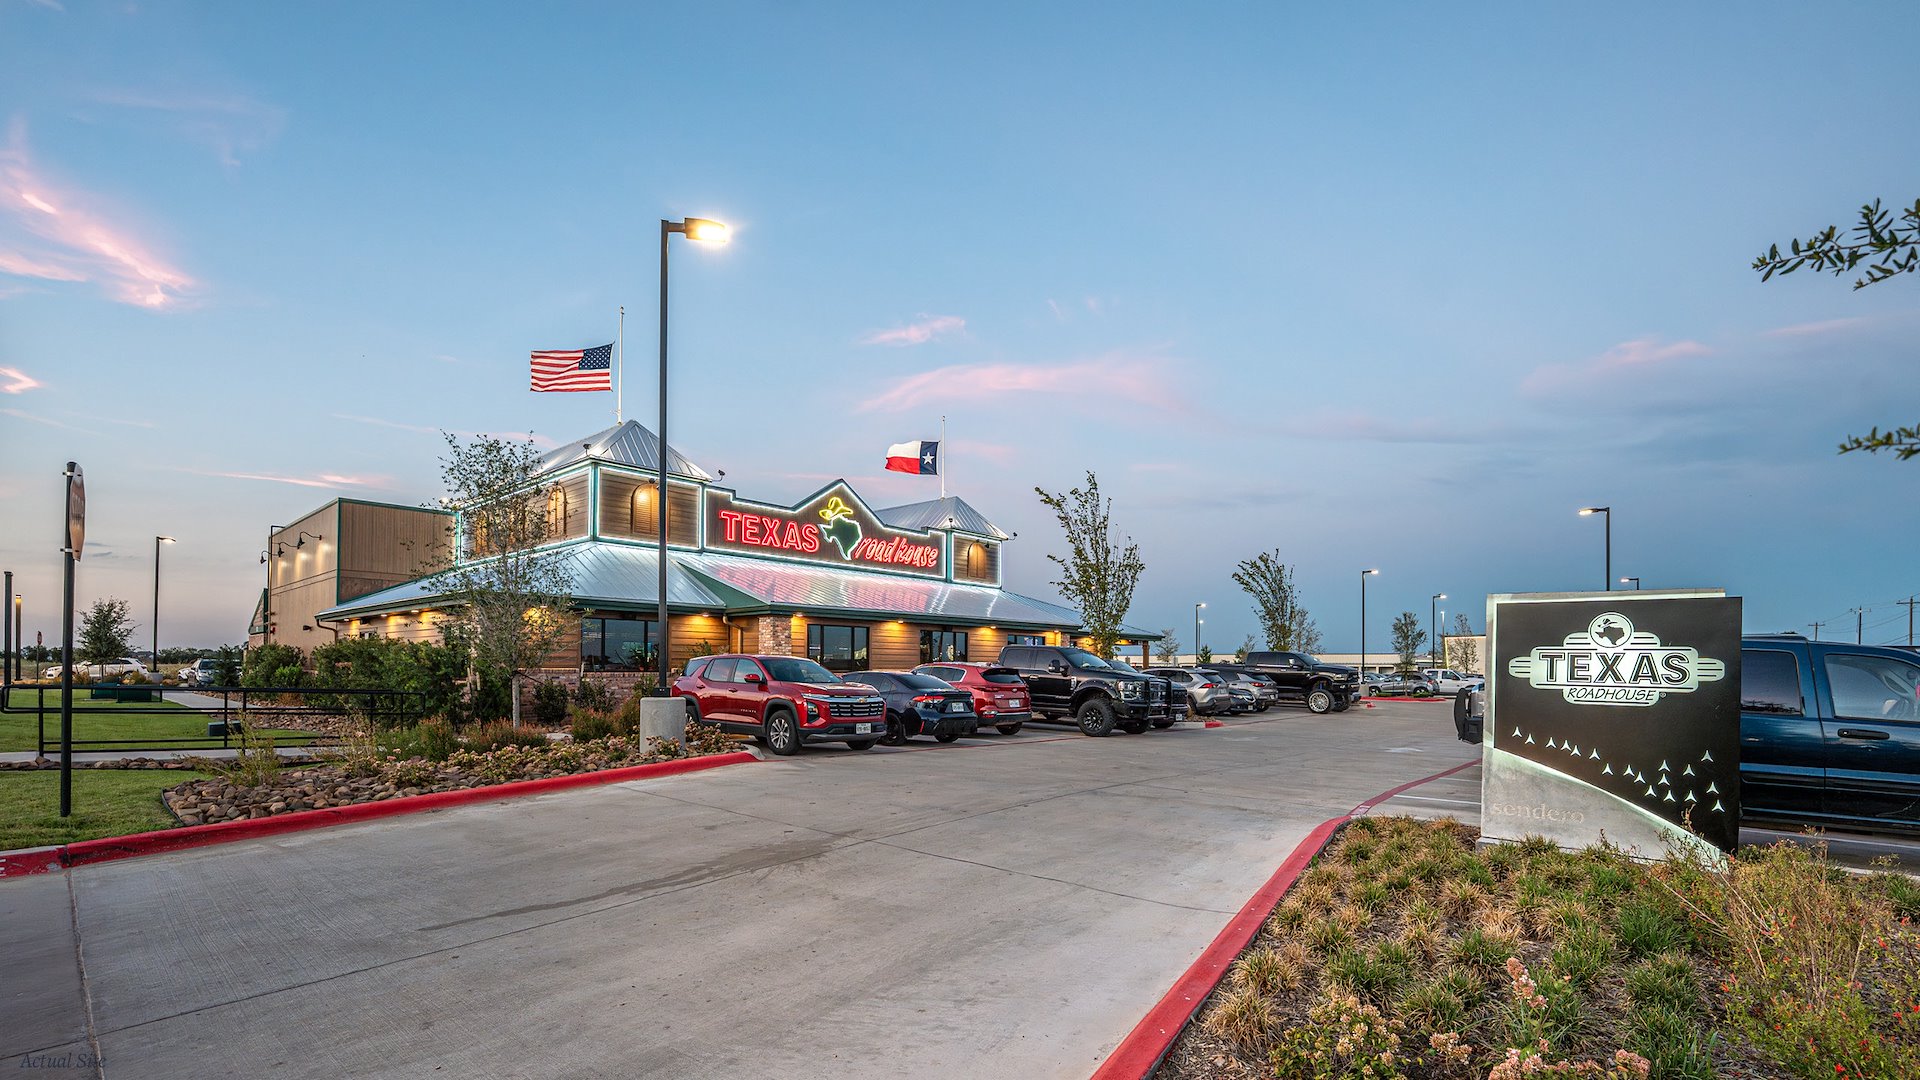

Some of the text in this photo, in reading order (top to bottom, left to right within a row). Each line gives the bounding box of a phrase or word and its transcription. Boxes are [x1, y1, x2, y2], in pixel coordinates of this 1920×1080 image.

[720, 510, 819, 552] TEXAS
[1538, 652, 1690, 685] TEXAS
[1567, 687, 1656, 701] ROADHOUSE
[1490, 802, 1584, 823] sendero
